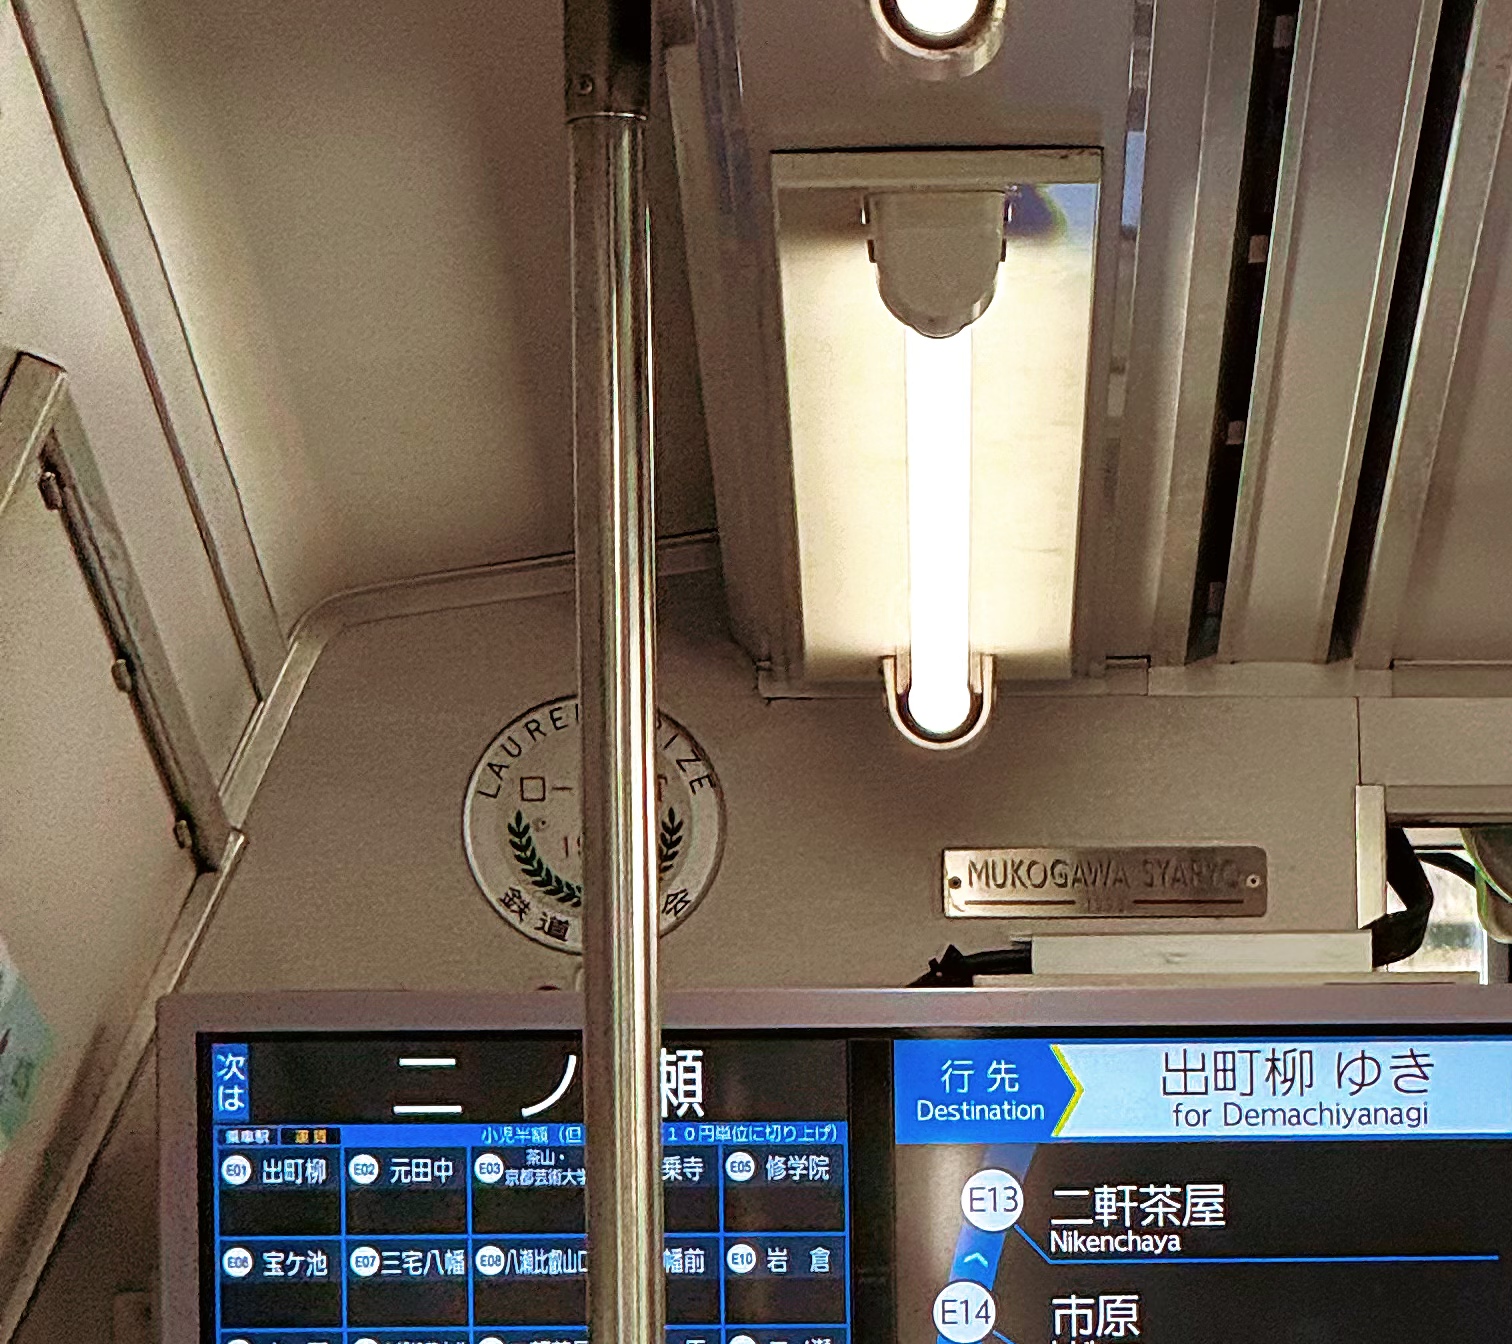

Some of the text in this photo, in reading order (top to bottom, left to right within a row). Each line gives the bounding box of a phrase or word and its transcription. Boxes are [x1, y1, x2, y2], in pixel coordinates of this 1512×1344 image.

[966, 858, 1133, 890] MUKOGAWA
[216, 1052, 245, 1111] 次は
[940, 1059, 1021, 1094] 行先
[1161, 1047, 1436, 1097] 出町柳 ゆき
[916, 1099, 1045, 1123] Destination
[1172, 1099, 1430, 1131] for Demachiyanagi
[226, 1157, 327, 1184] E01 出町柳
[353, 1157, 454, 1184] E02 元田中
[479, 1159, 502, 1176] E03
[661, 1155, 704, 1182] 乗寺
[765, 1154, 830, 1181] 修学院
[968, 1184, 1226, 1229] E13 二軒茶屋
[1050, 1230, 1182, 1256] Nikenchaya
[354, 1249, 466, 1276] E07 三宅八幡
[663, 1246, 705, 1275] 幡前
[731, 1247, 831, 1274] E10 岩倉
[940, 1295, 1140, 1338] E14 市原
